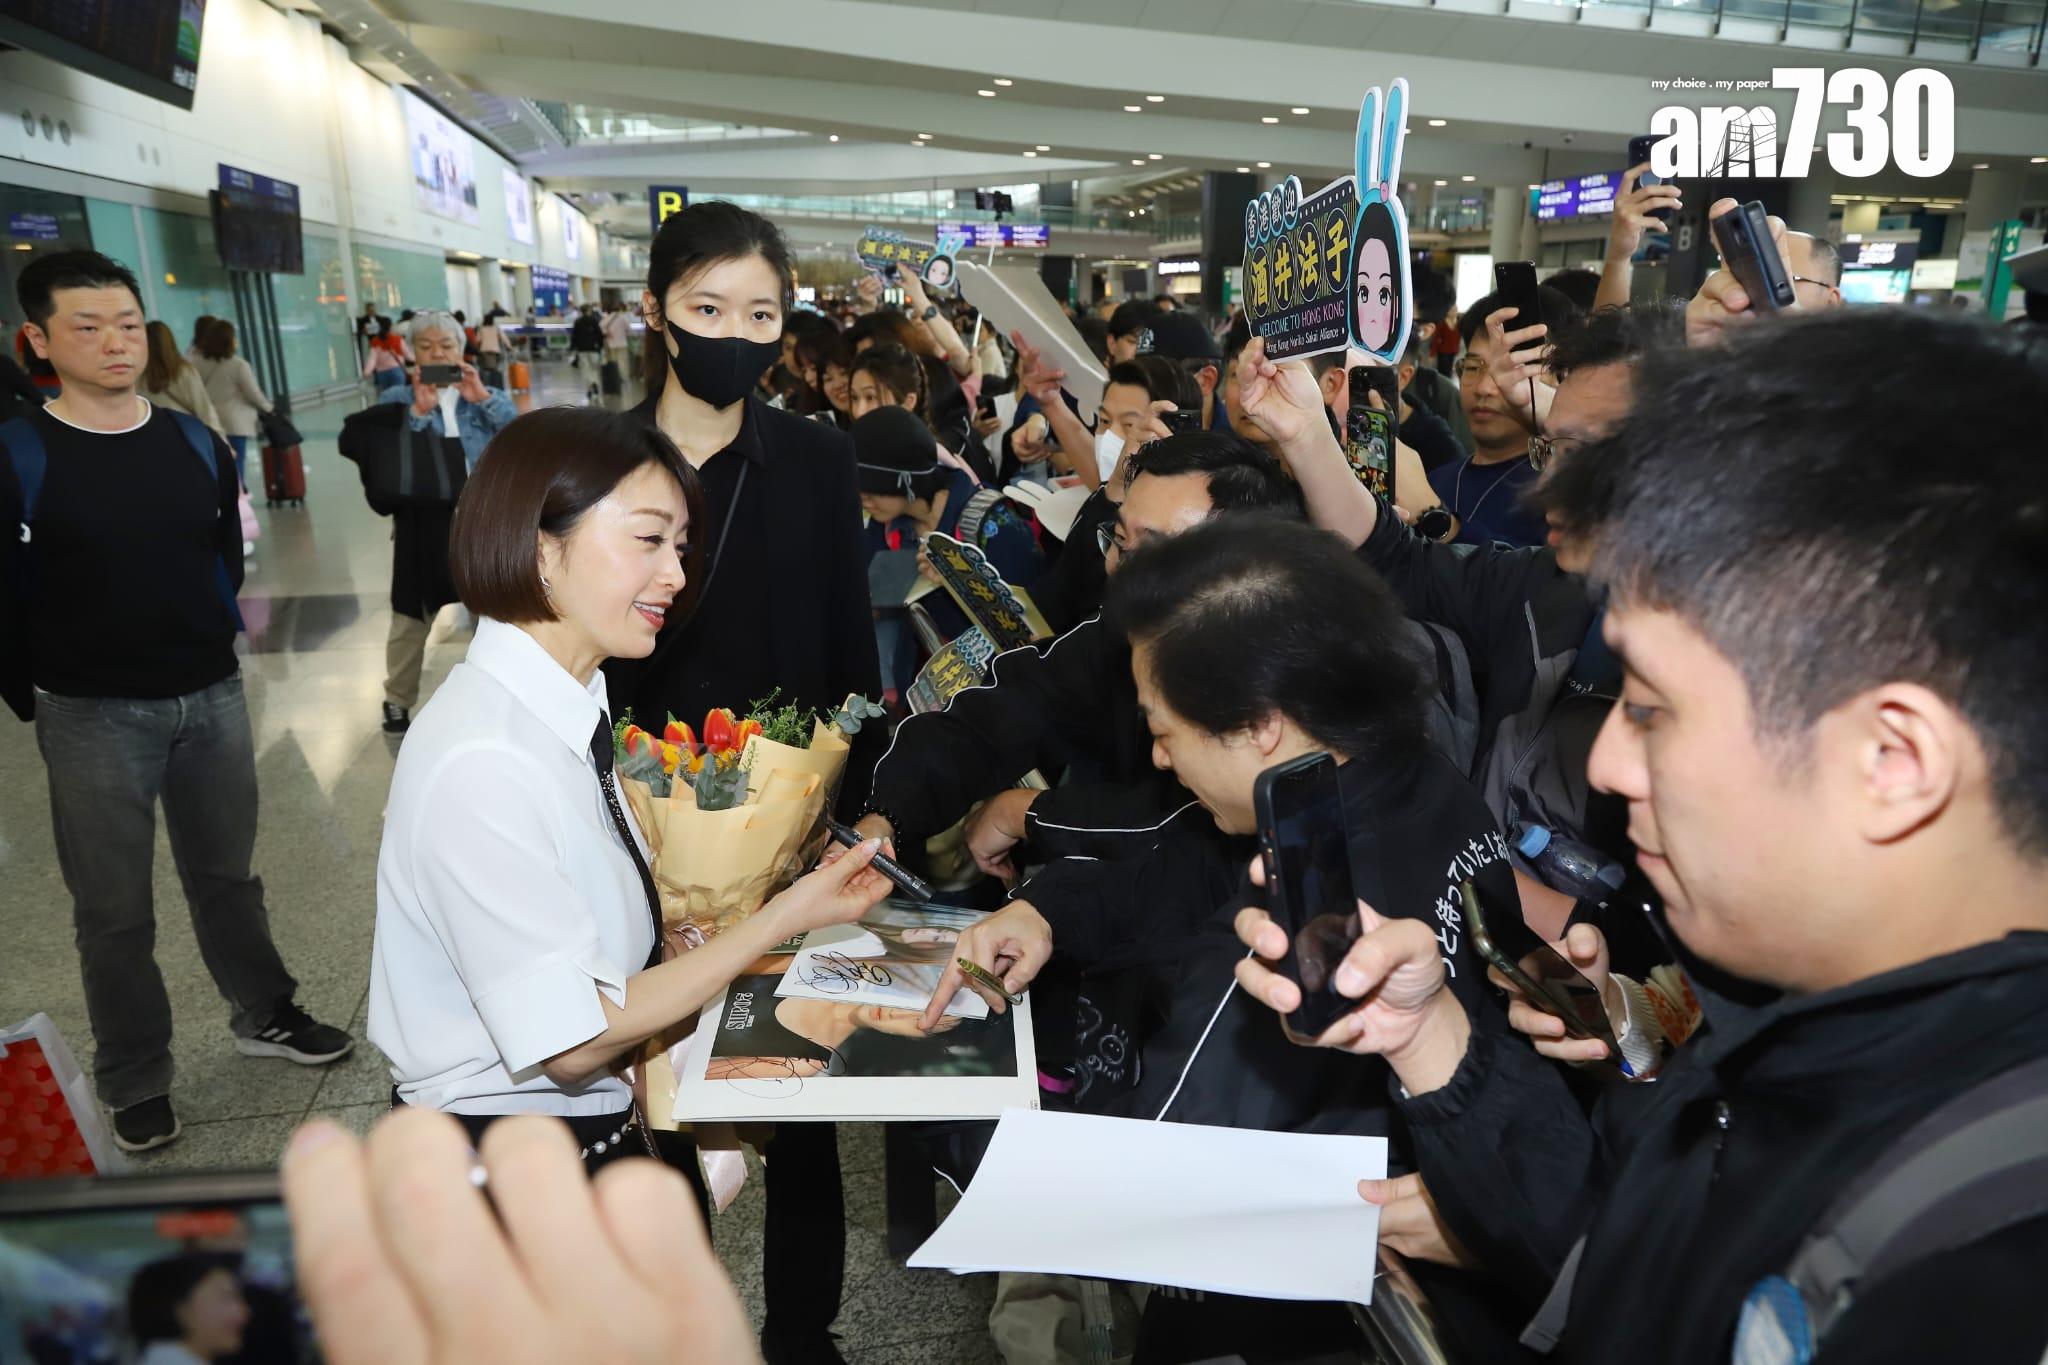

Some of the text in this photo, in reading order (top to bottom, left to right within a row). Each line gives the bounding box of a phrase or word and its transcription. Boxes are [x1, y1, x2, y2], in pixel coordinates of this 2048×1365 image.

[1251, 217, 1349, 308] 酒井法子
[1259, 299, 1345, 338] WELCOME TO HONG KONG
[1319, 326, 1340, 342] Alliance
